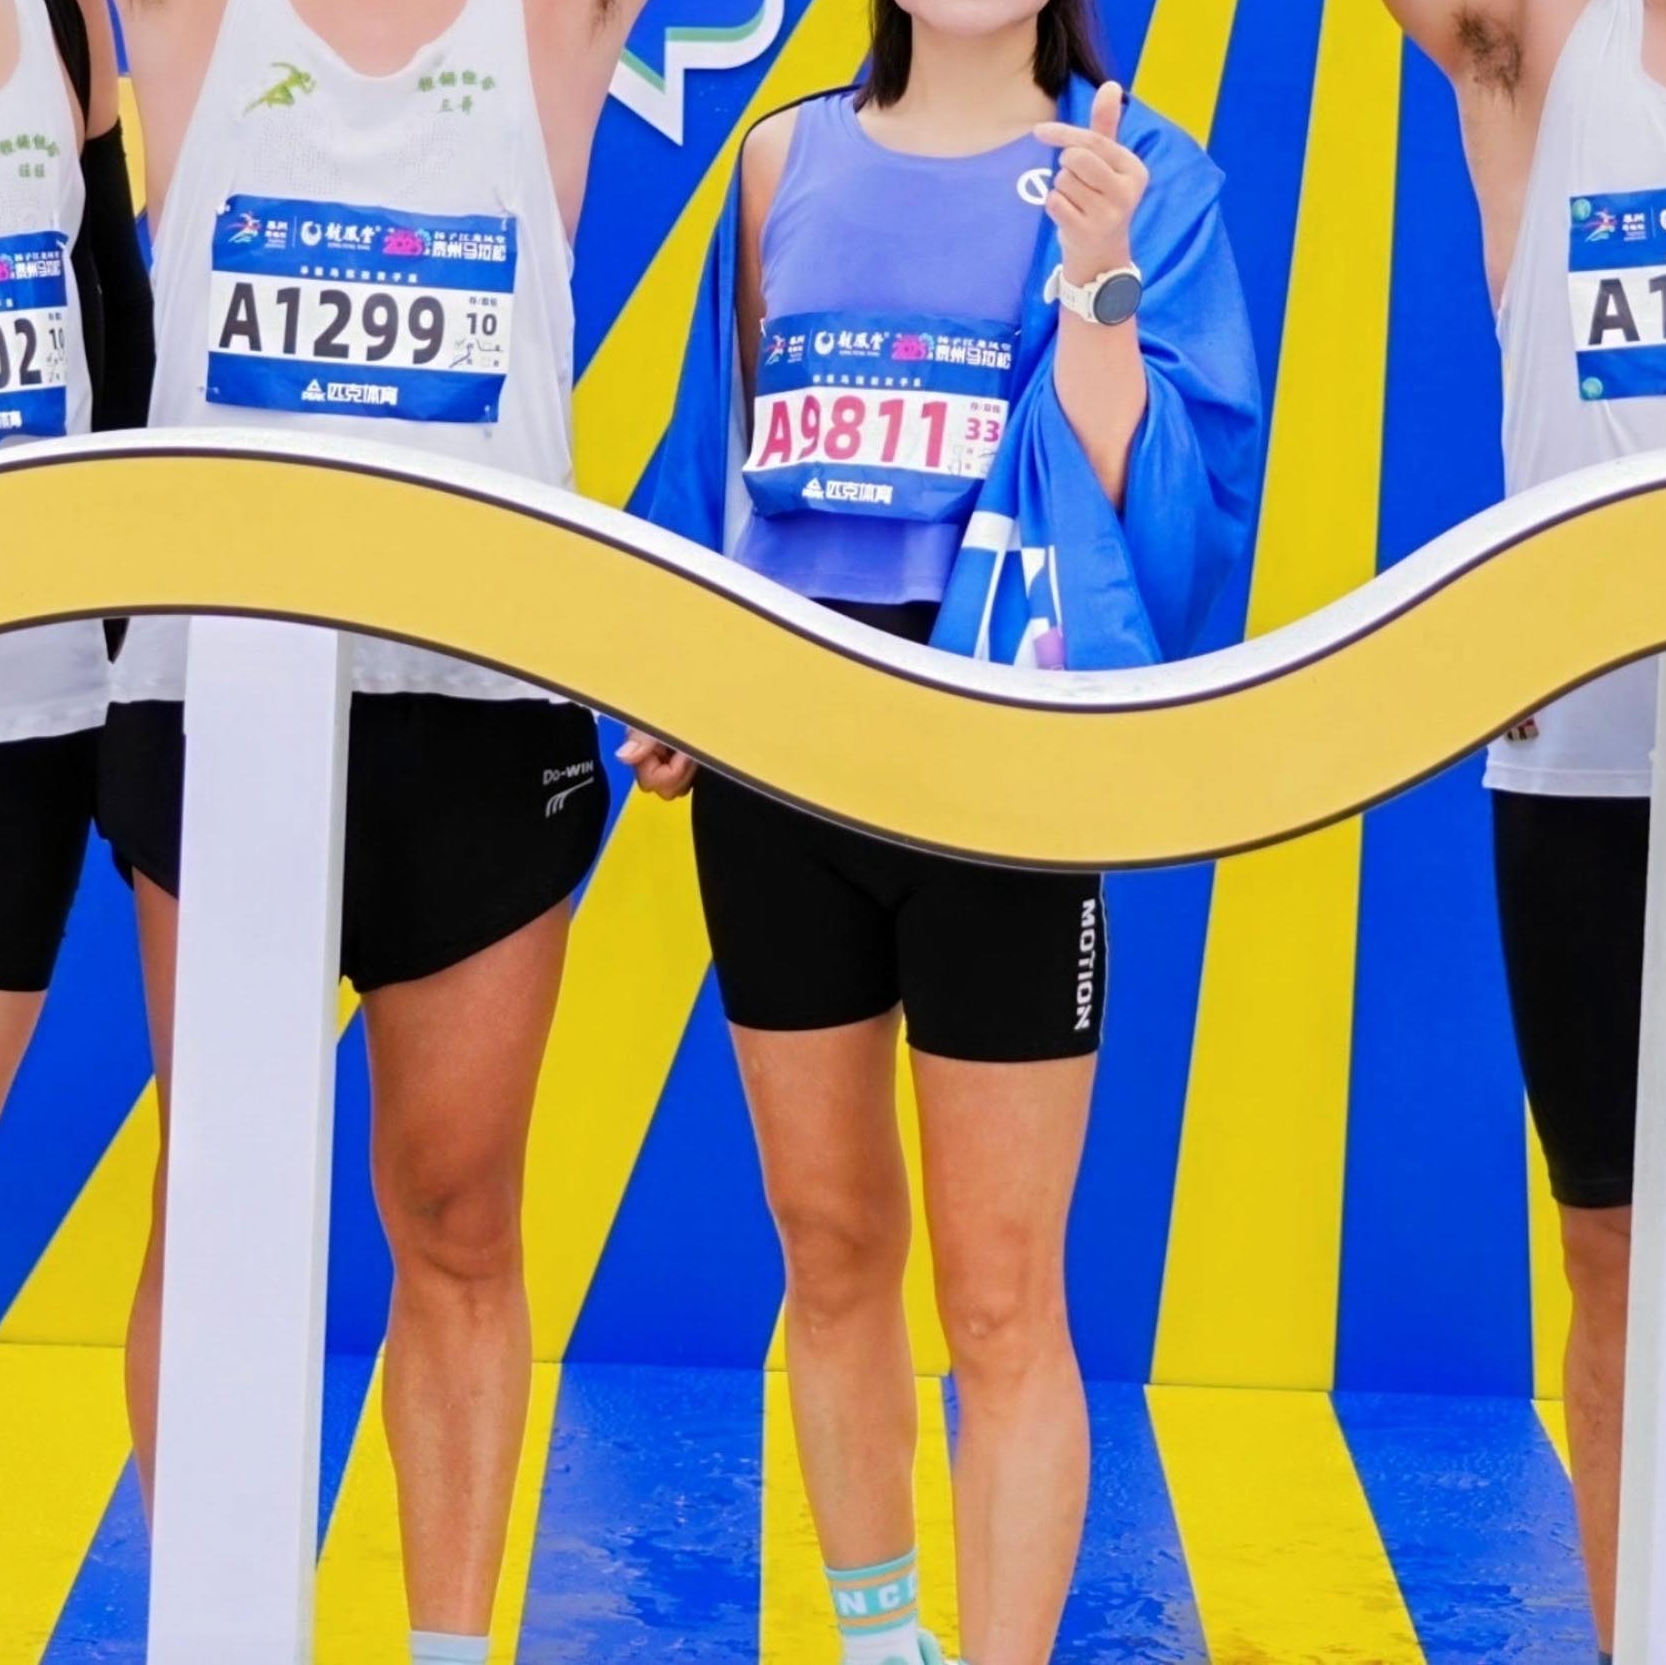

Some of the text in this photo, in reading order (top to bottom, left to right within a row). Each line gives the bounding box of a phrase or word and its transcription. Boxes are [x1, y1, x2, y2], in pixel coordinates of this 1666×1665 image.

[218, 281, 446, 366] A1299
[466, 311, 498, 336] 10
[755, 394, 948, 468] A9811
[965, 418, 1000, 444] 33
[1074, 897, 1097, 1032] MOTION
